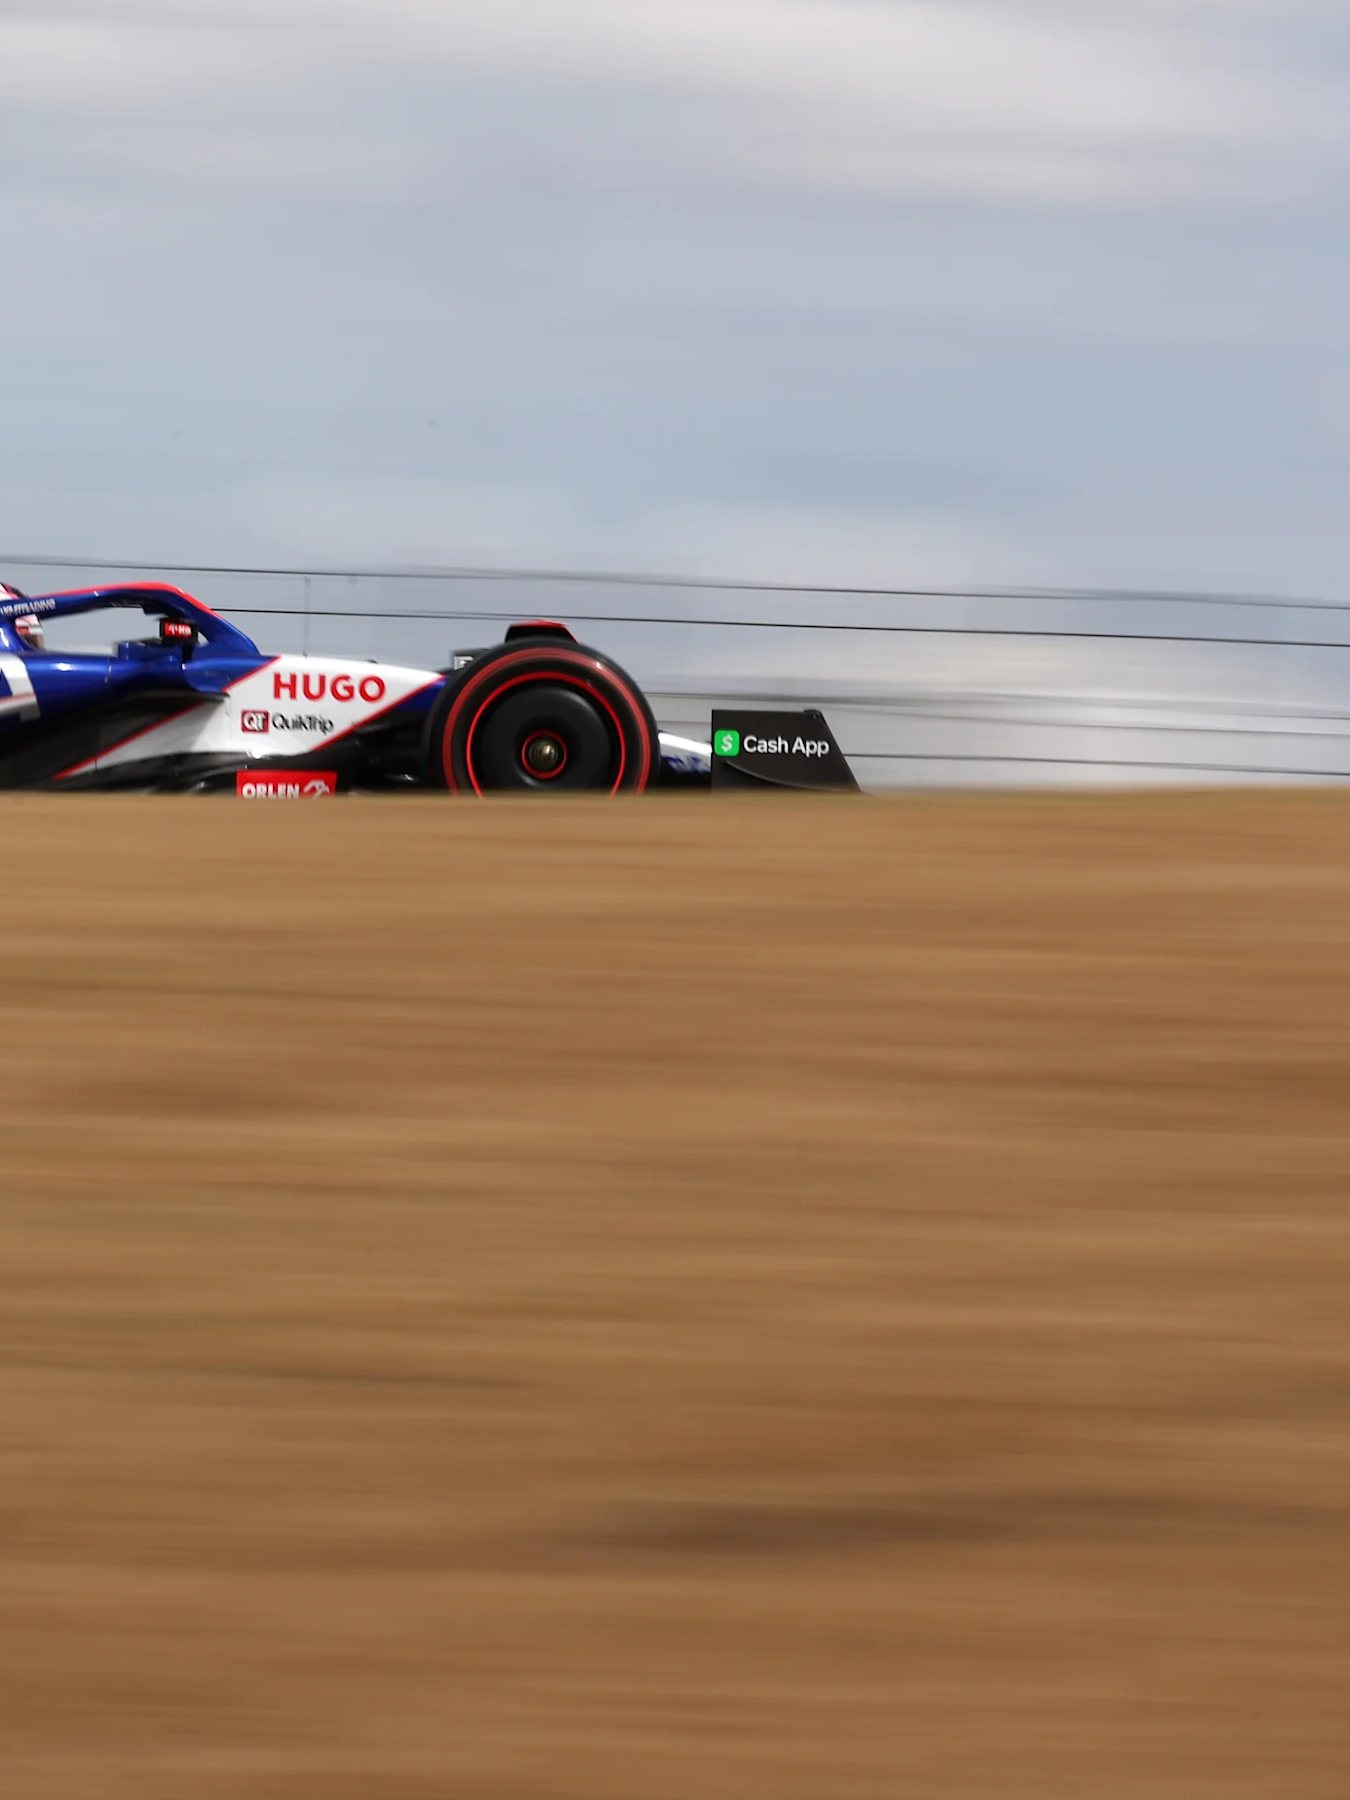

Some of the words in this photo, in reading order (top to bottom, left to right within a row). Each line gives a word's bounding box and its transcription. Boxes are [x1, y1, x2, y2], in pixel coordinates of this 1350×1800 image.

[273, 672, 386, 702] HUGO
[243, 711, 266, 731] QT
[272, 713, 334, 735] QuikTrip
[743, 736, 789, 753] Cash
[792, 737, 830, 757] App
[242, 783, 299, 799] ORLEN
